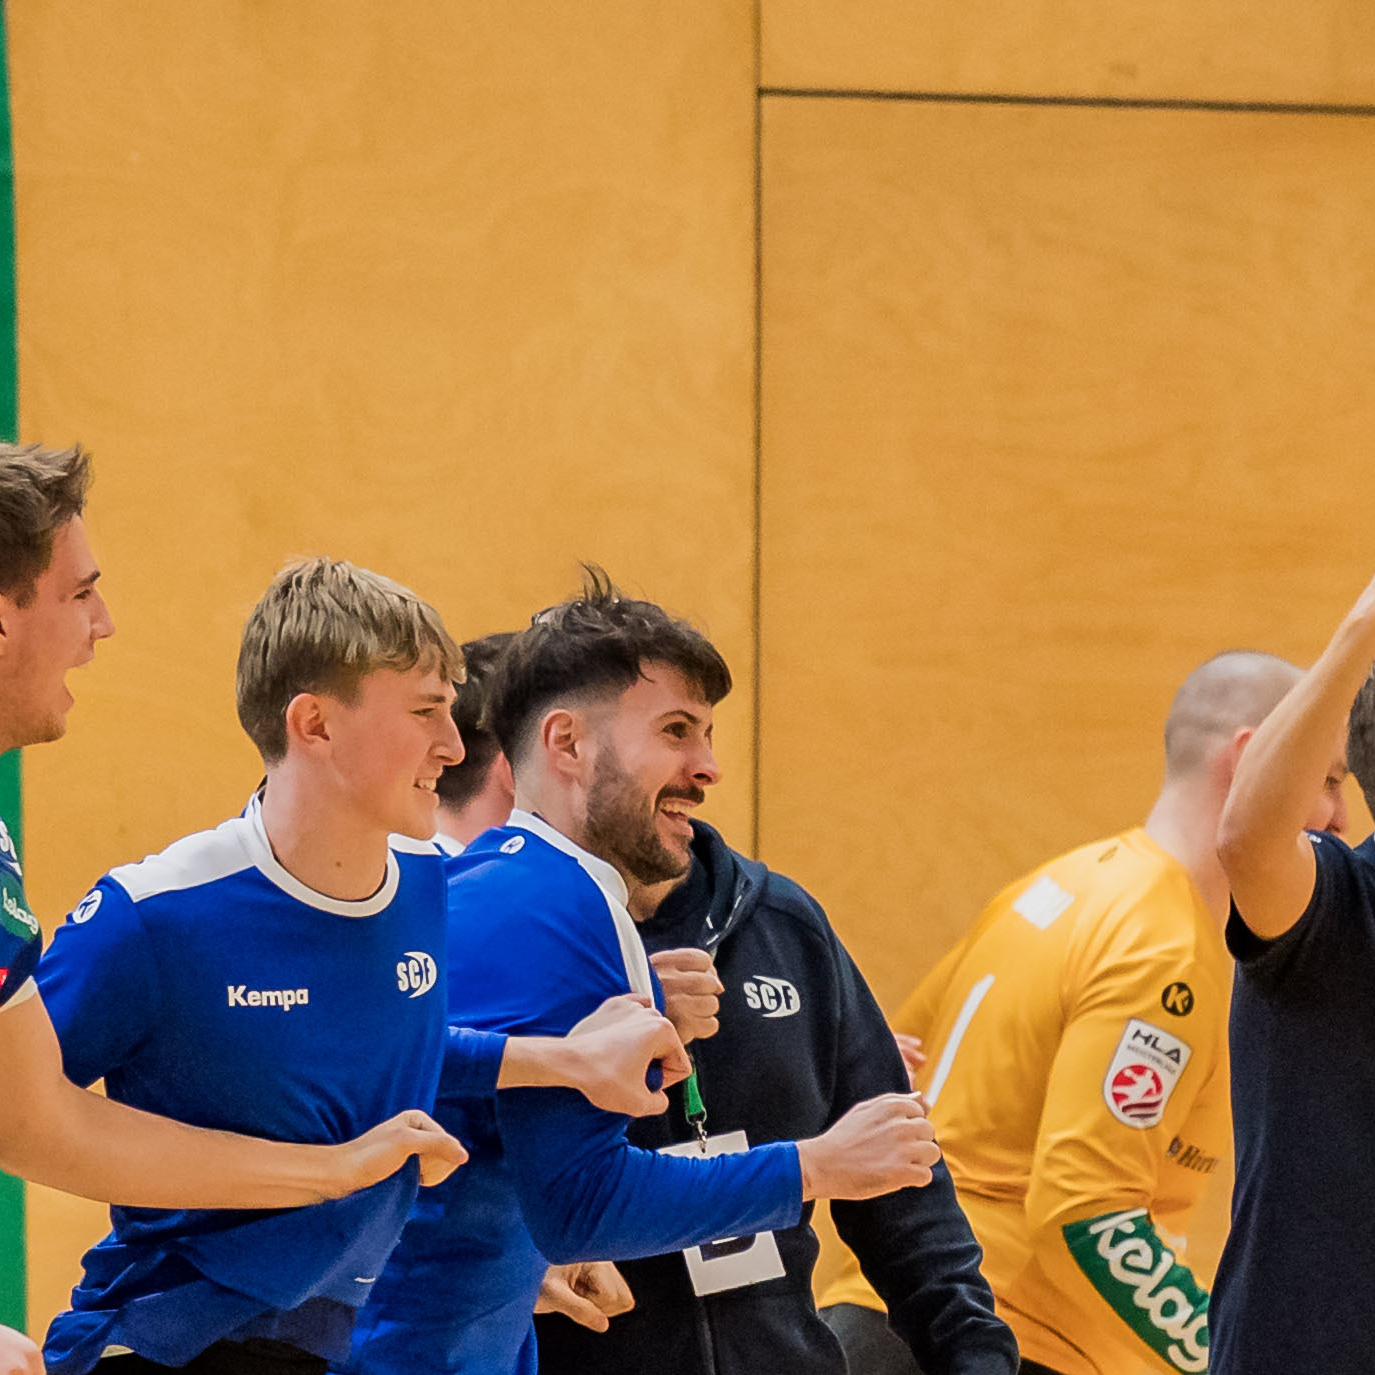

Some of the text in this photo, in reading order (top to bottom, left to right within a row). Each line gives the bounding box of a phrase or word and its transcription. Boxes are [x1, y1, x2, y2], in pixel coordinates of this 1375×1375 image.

[227, 985, 309, 1011] Kempa
[743, 978, 799, 1015] SCF
[1132, 1029, 1181, 1064] HLA
